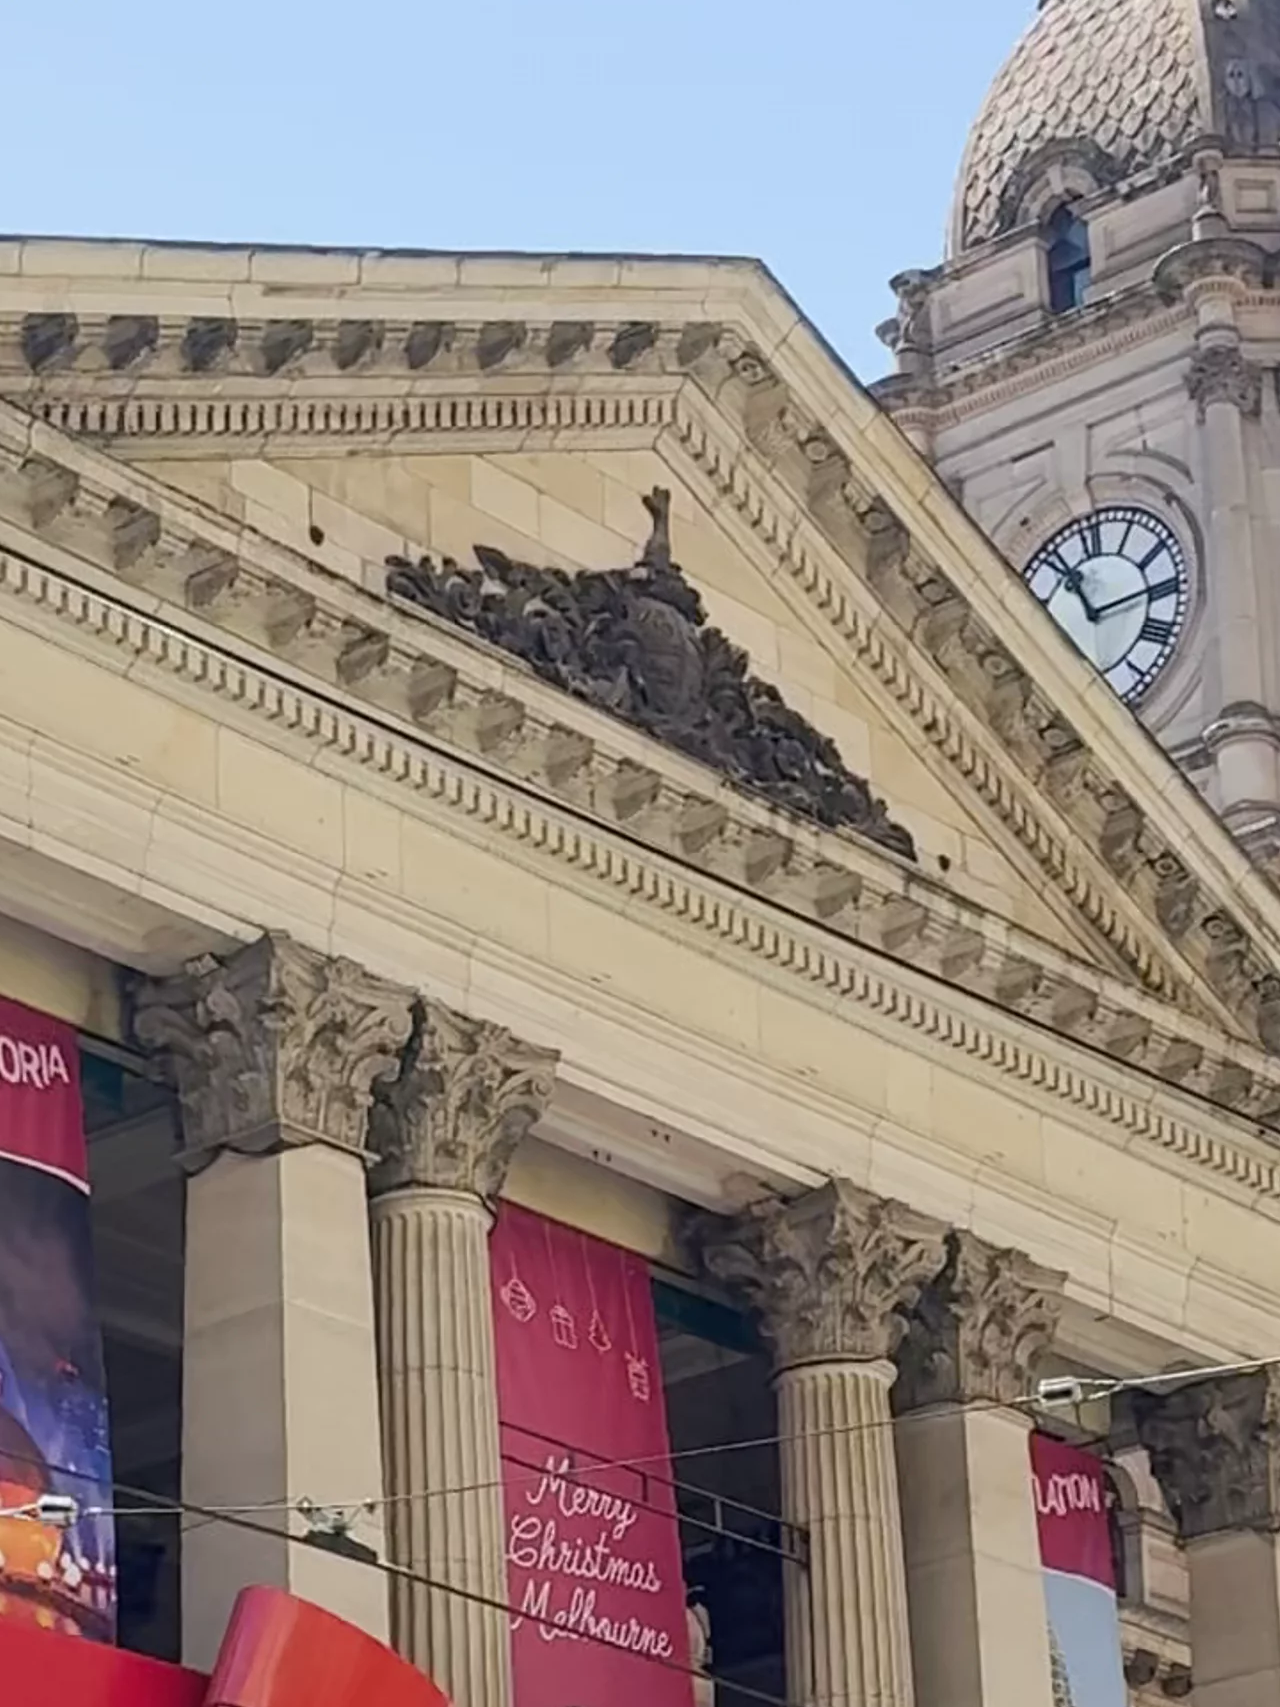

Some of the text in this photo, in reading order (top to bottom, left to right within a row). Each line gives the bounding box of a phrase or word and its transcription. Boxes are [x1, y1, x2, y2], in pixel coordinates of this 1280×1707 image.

[526, 1454, 637, 1540] Merry
[506, 1513, 662, 1593] Christmas
[510, 1579, 673, 1658] Melbourne
